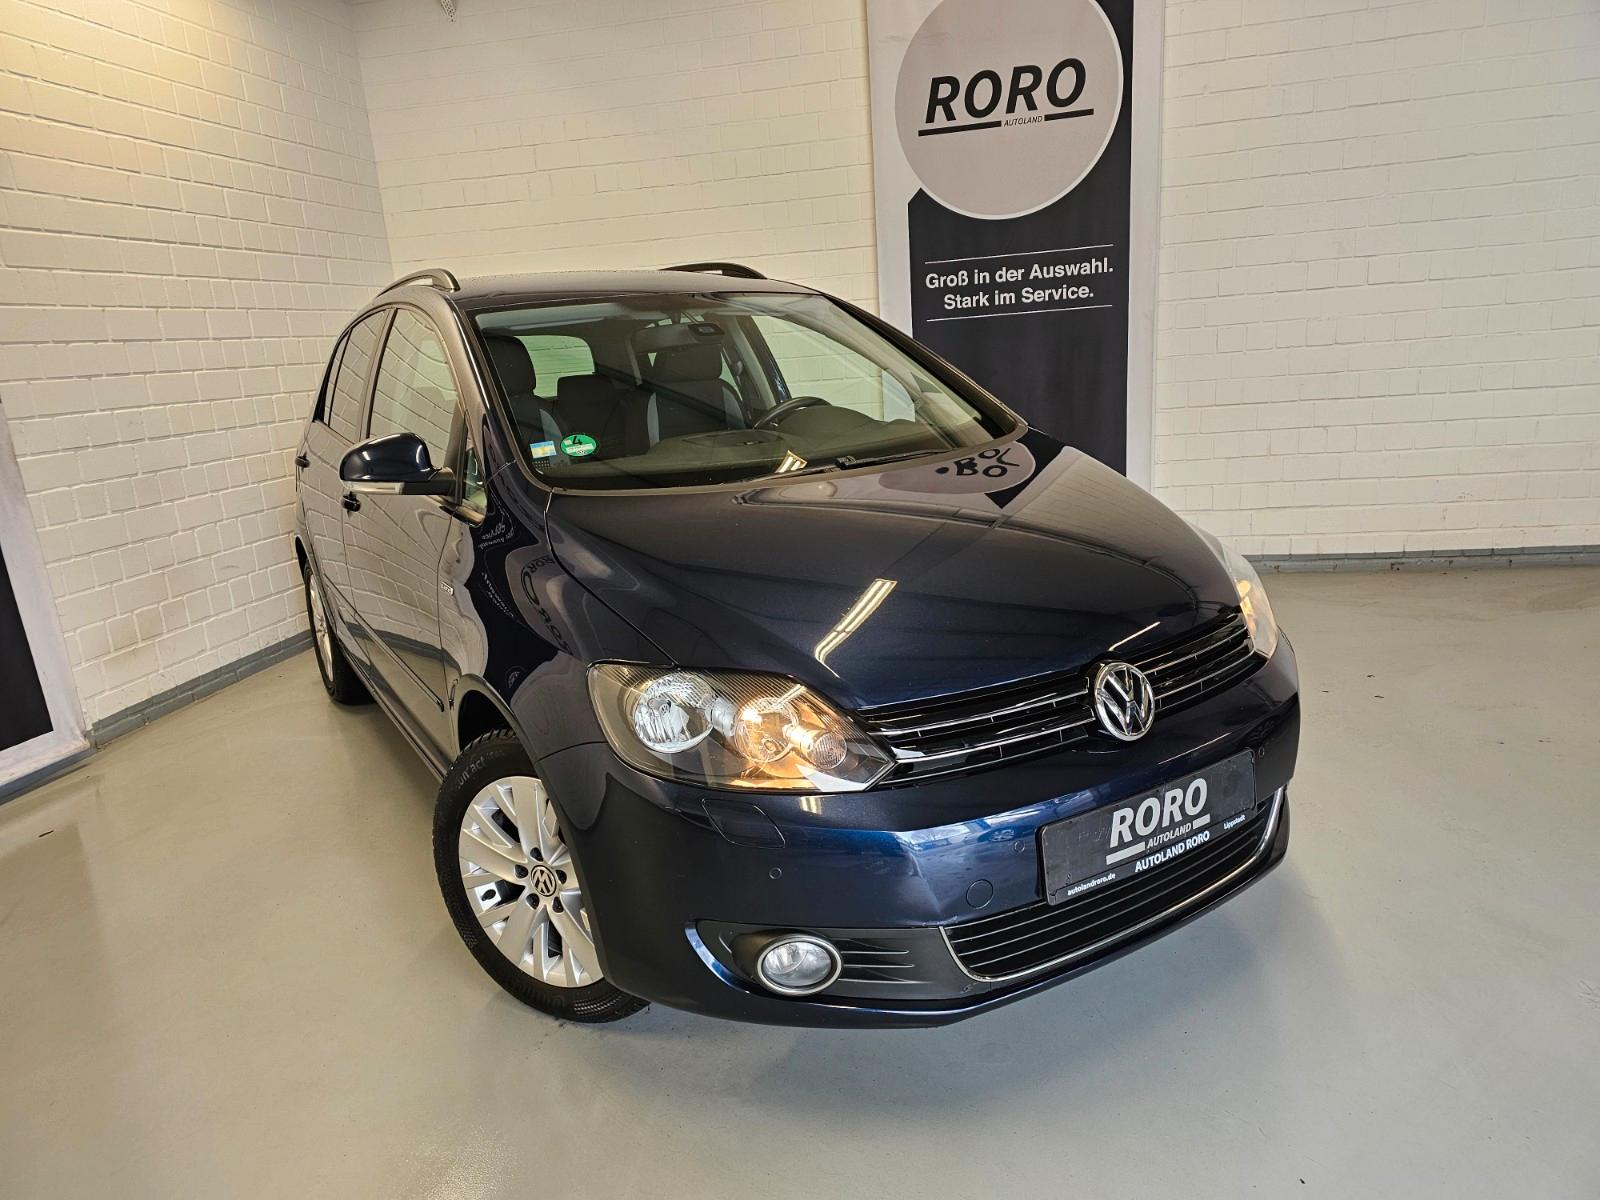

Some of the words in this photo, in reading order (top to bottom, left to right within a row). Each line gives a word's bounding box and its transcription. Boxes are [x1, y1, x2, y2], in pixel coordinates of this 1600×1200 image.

[925, 57, 1087, 124] RORO
[1003, 115, 1043, 127] AUTOLAND
[925, 269, 969, 289] Groß
[974, 268, 990, 285] in
[995, 266, 1025, 283] der
[1029, 257, 1114, 280] Auswahl.
[944, 291, 990, 310] Stark
[994, 289, 1016, 306] im
[1021, 284, 1094, 304] Service.
[1109, 777, 1208, 848] RORO
[1147, 822, 1192, 850] AUTOLAND
[1067, 872, 1116, 896] autolandroro.de
[1134, 842, 1185, 873] AUTOLAND
[1186, 830, 1210, 850] RORO
